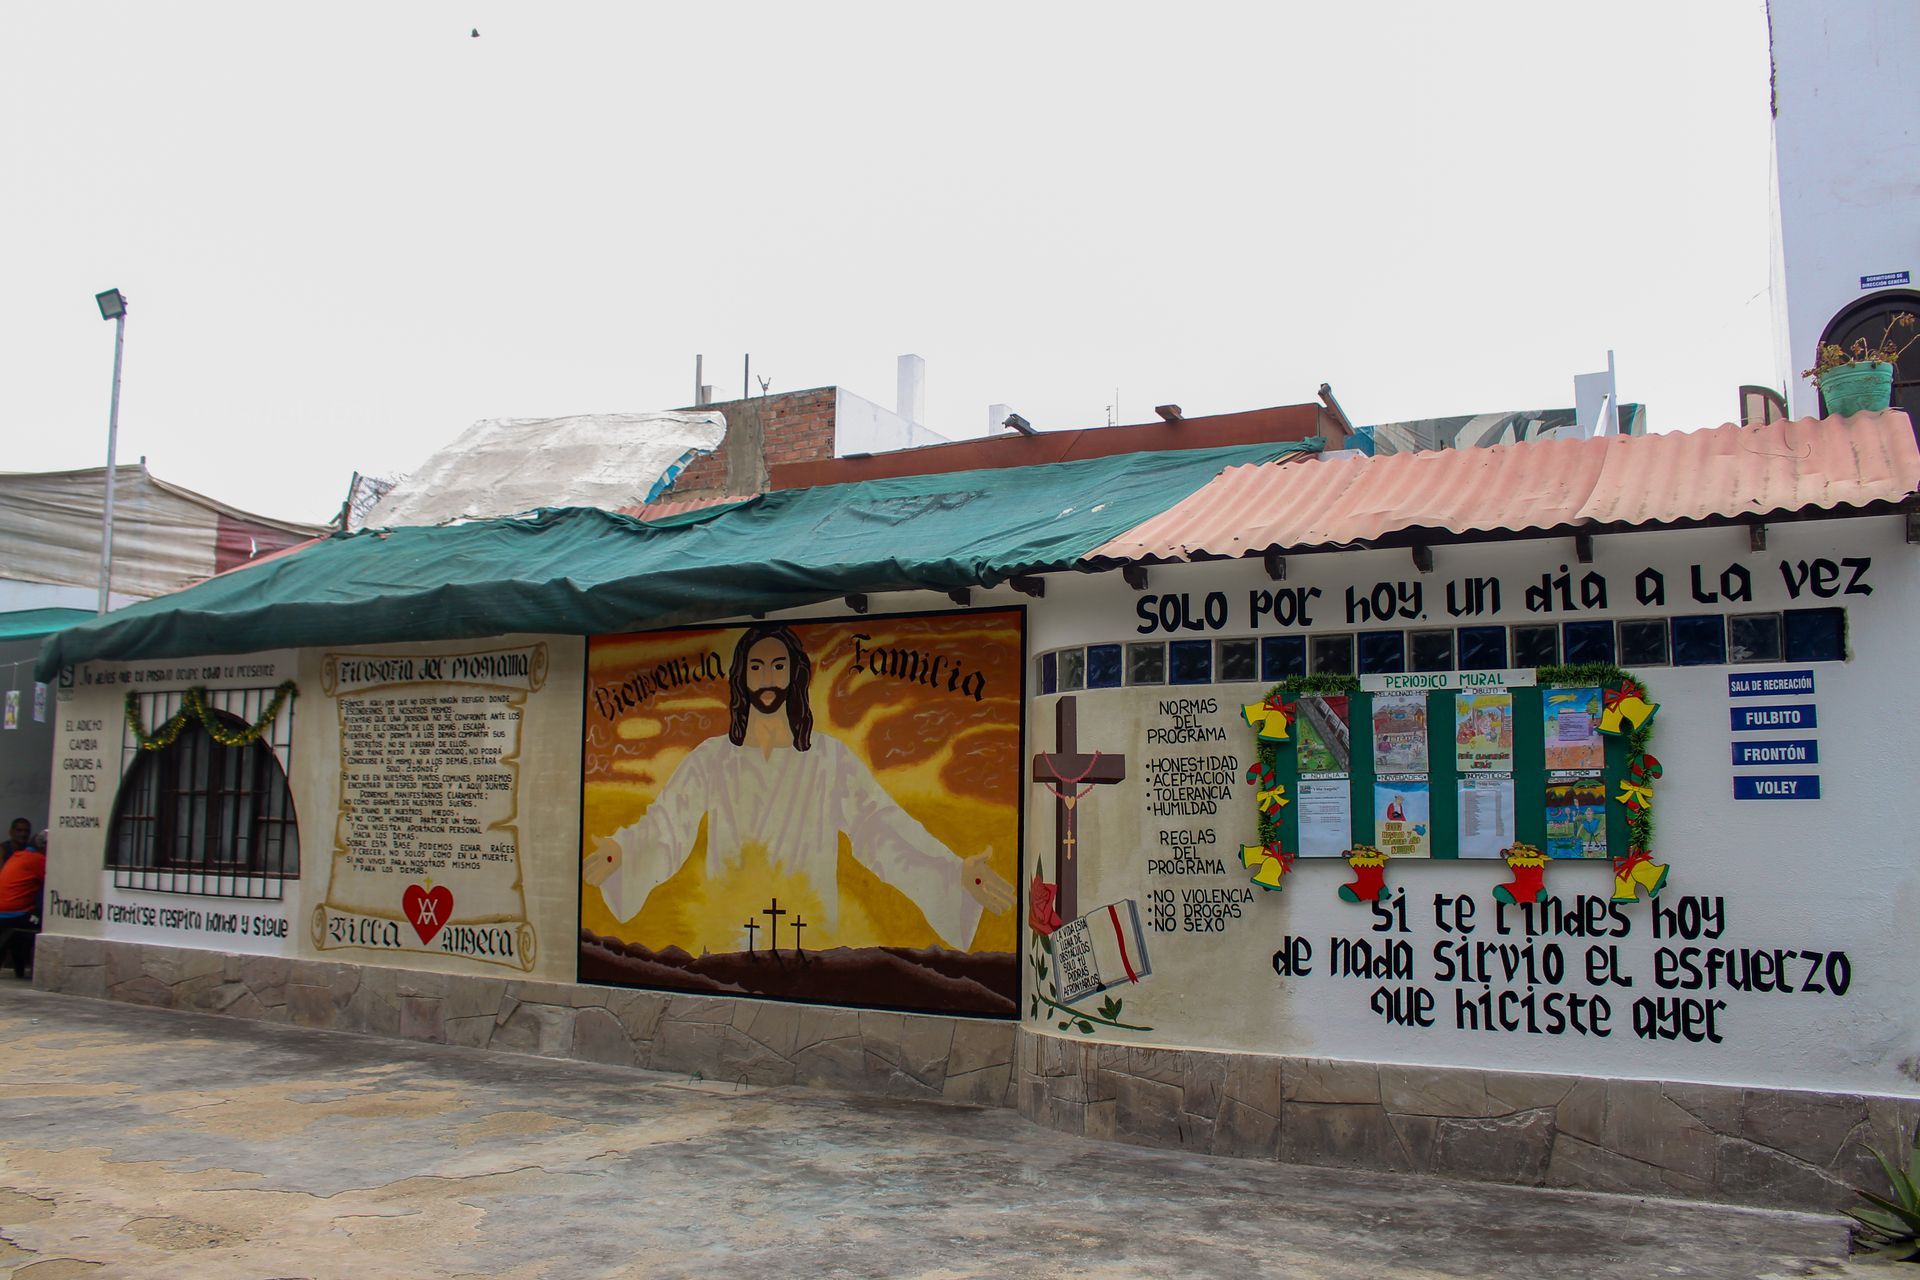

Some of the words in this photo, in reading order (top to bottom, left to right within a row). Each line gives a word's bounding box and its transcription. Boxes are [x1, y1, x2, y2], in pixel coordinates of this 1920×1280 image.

[594, 650, 729, 721] Bienvenida
[850, 633, 986, 702] Familia
[1459, 672, 1505, 686] MURAL
[1731, 680, 1751, 693] SALA
[1752, 679, 1762, 692] DE
[1763, 676, 1812, 691] RECREACIÓN
[1159, 698, 1218, 716] NORMAS
[66, 720, 74, 732] EL
[1172, 714, 1202, 730] DEL
[1745, 710, 1801, 726] FULBITO
[1148, 727, 1226, 744] PROGRAMA
[69, 739, 98, 751] CAMBIA
[1743, 744, 1806, 762] FRONTÓN
[63, 758, 93, 770] GRACIAS
[96, 758, 103, 770] A
[1151, 756, 1238, 774] HONESTIDAD
[70, 774, 96, 792] DIOS
[1153, 770, 1236, 788] ACEPTACIÓN
[1153, 785, 1232, 802] TOLERANCIA
[1755, 781, 1798, 796] VOLEY
[70, 798, 75, 809] Y
[1153, 800, 1218, 816] HUMILDAD
[59, 816, 100, 828] PROGRAMA
[1160, 828, 1216, 846] REGLAS
[1173, 846, 1201, 862] DEL
[452, 861, 480, 870] MISMOS
[1148, 858, 1226, 876] PROGRAMA
[1154, 889, 1176, 904] NO
[1182, 888, 1254, 904] VIOLENCIA
[1154, 904, 1176, 918] NO
[1183, 903, 1242, 919] DROGAS
[241, 915, 250, 935] y
[253, 914, 289, 938] sigue
[329, 917, 402, 948] Villa
[1062, 924, 1075, 939] VIDA
[1154, 918, 1176, 933] NO
[1183, 917, 1225, 933] SEXO
[1075, 933, 1083, 945] DE
[1063, 959, 1077, 974] SOLO
[1063, 973, 1101, 998] AFRONTARLOS
